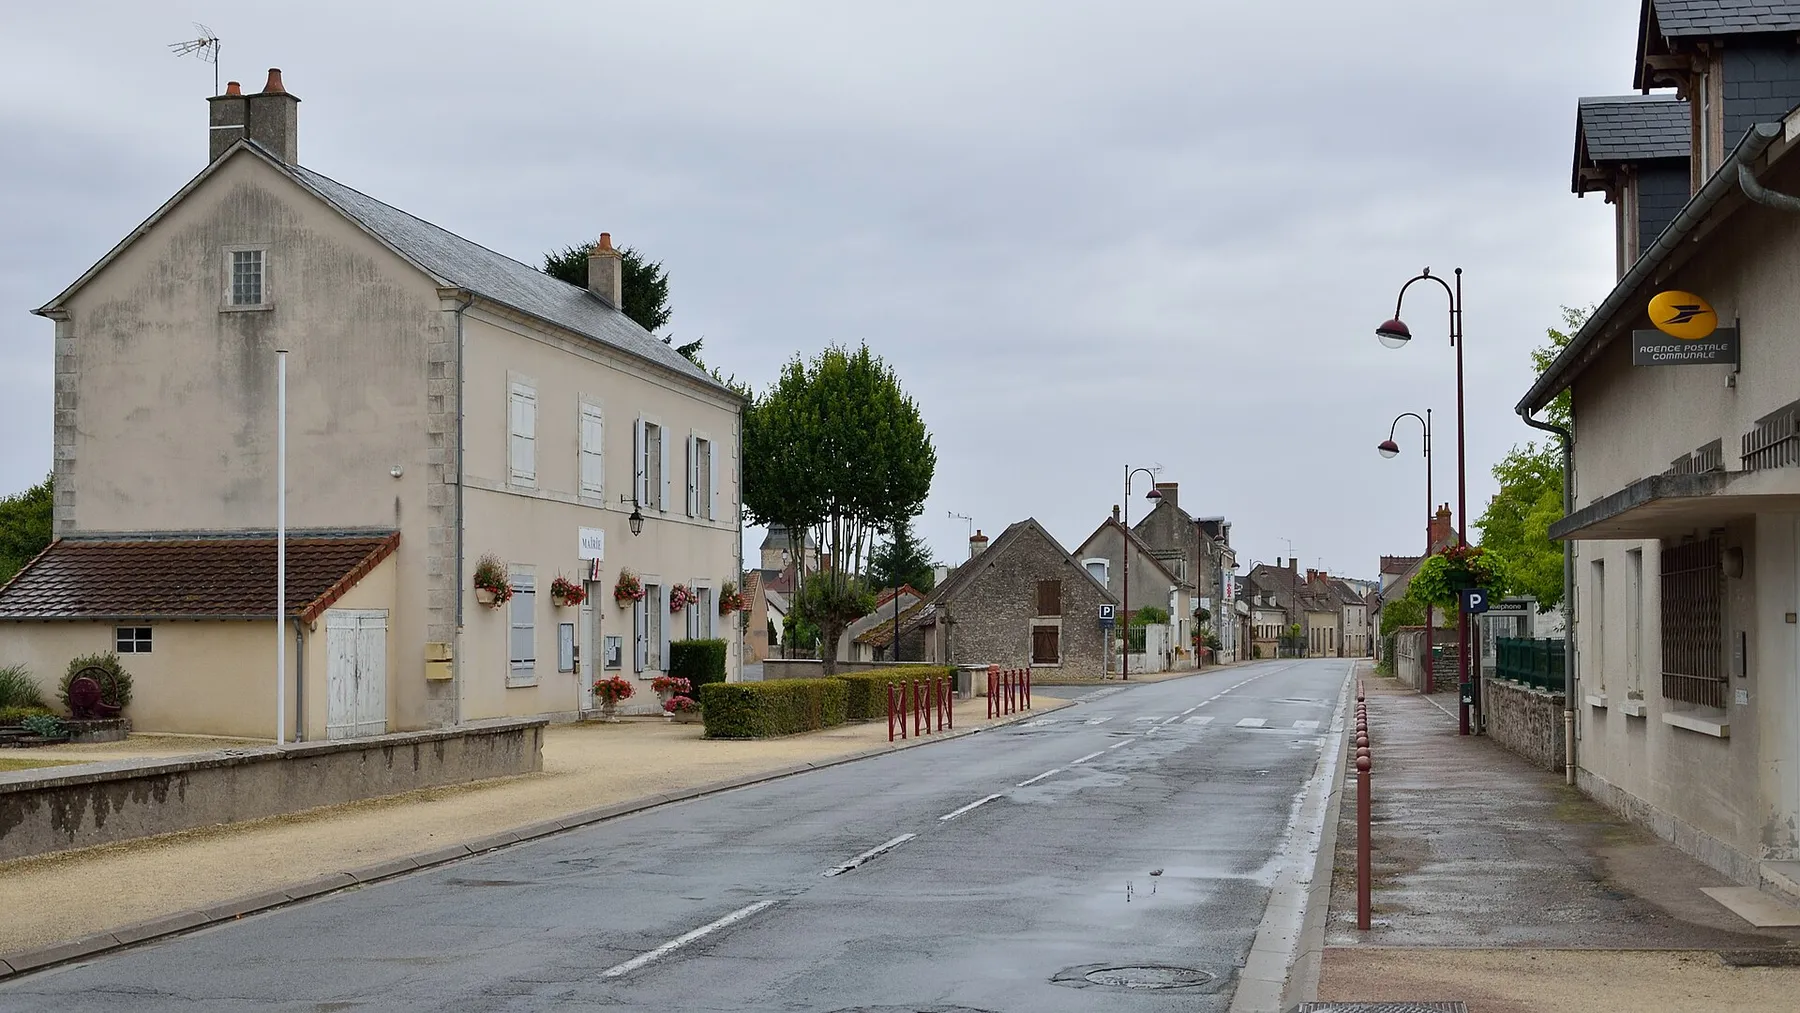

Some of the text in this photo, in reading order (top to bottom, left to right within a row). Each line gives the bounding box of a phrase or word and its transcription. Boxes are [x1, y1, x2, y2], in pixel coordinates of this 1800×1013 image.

[1640, 343, 1728, 353] AGENCE POSTALE
[1652, 351, 1715, 360] COMMUNALE
[582, 536, 602, 550] MAIRIE
[1470, 594, 1482, 608] P
[1104, 607, 1111, 616] P
